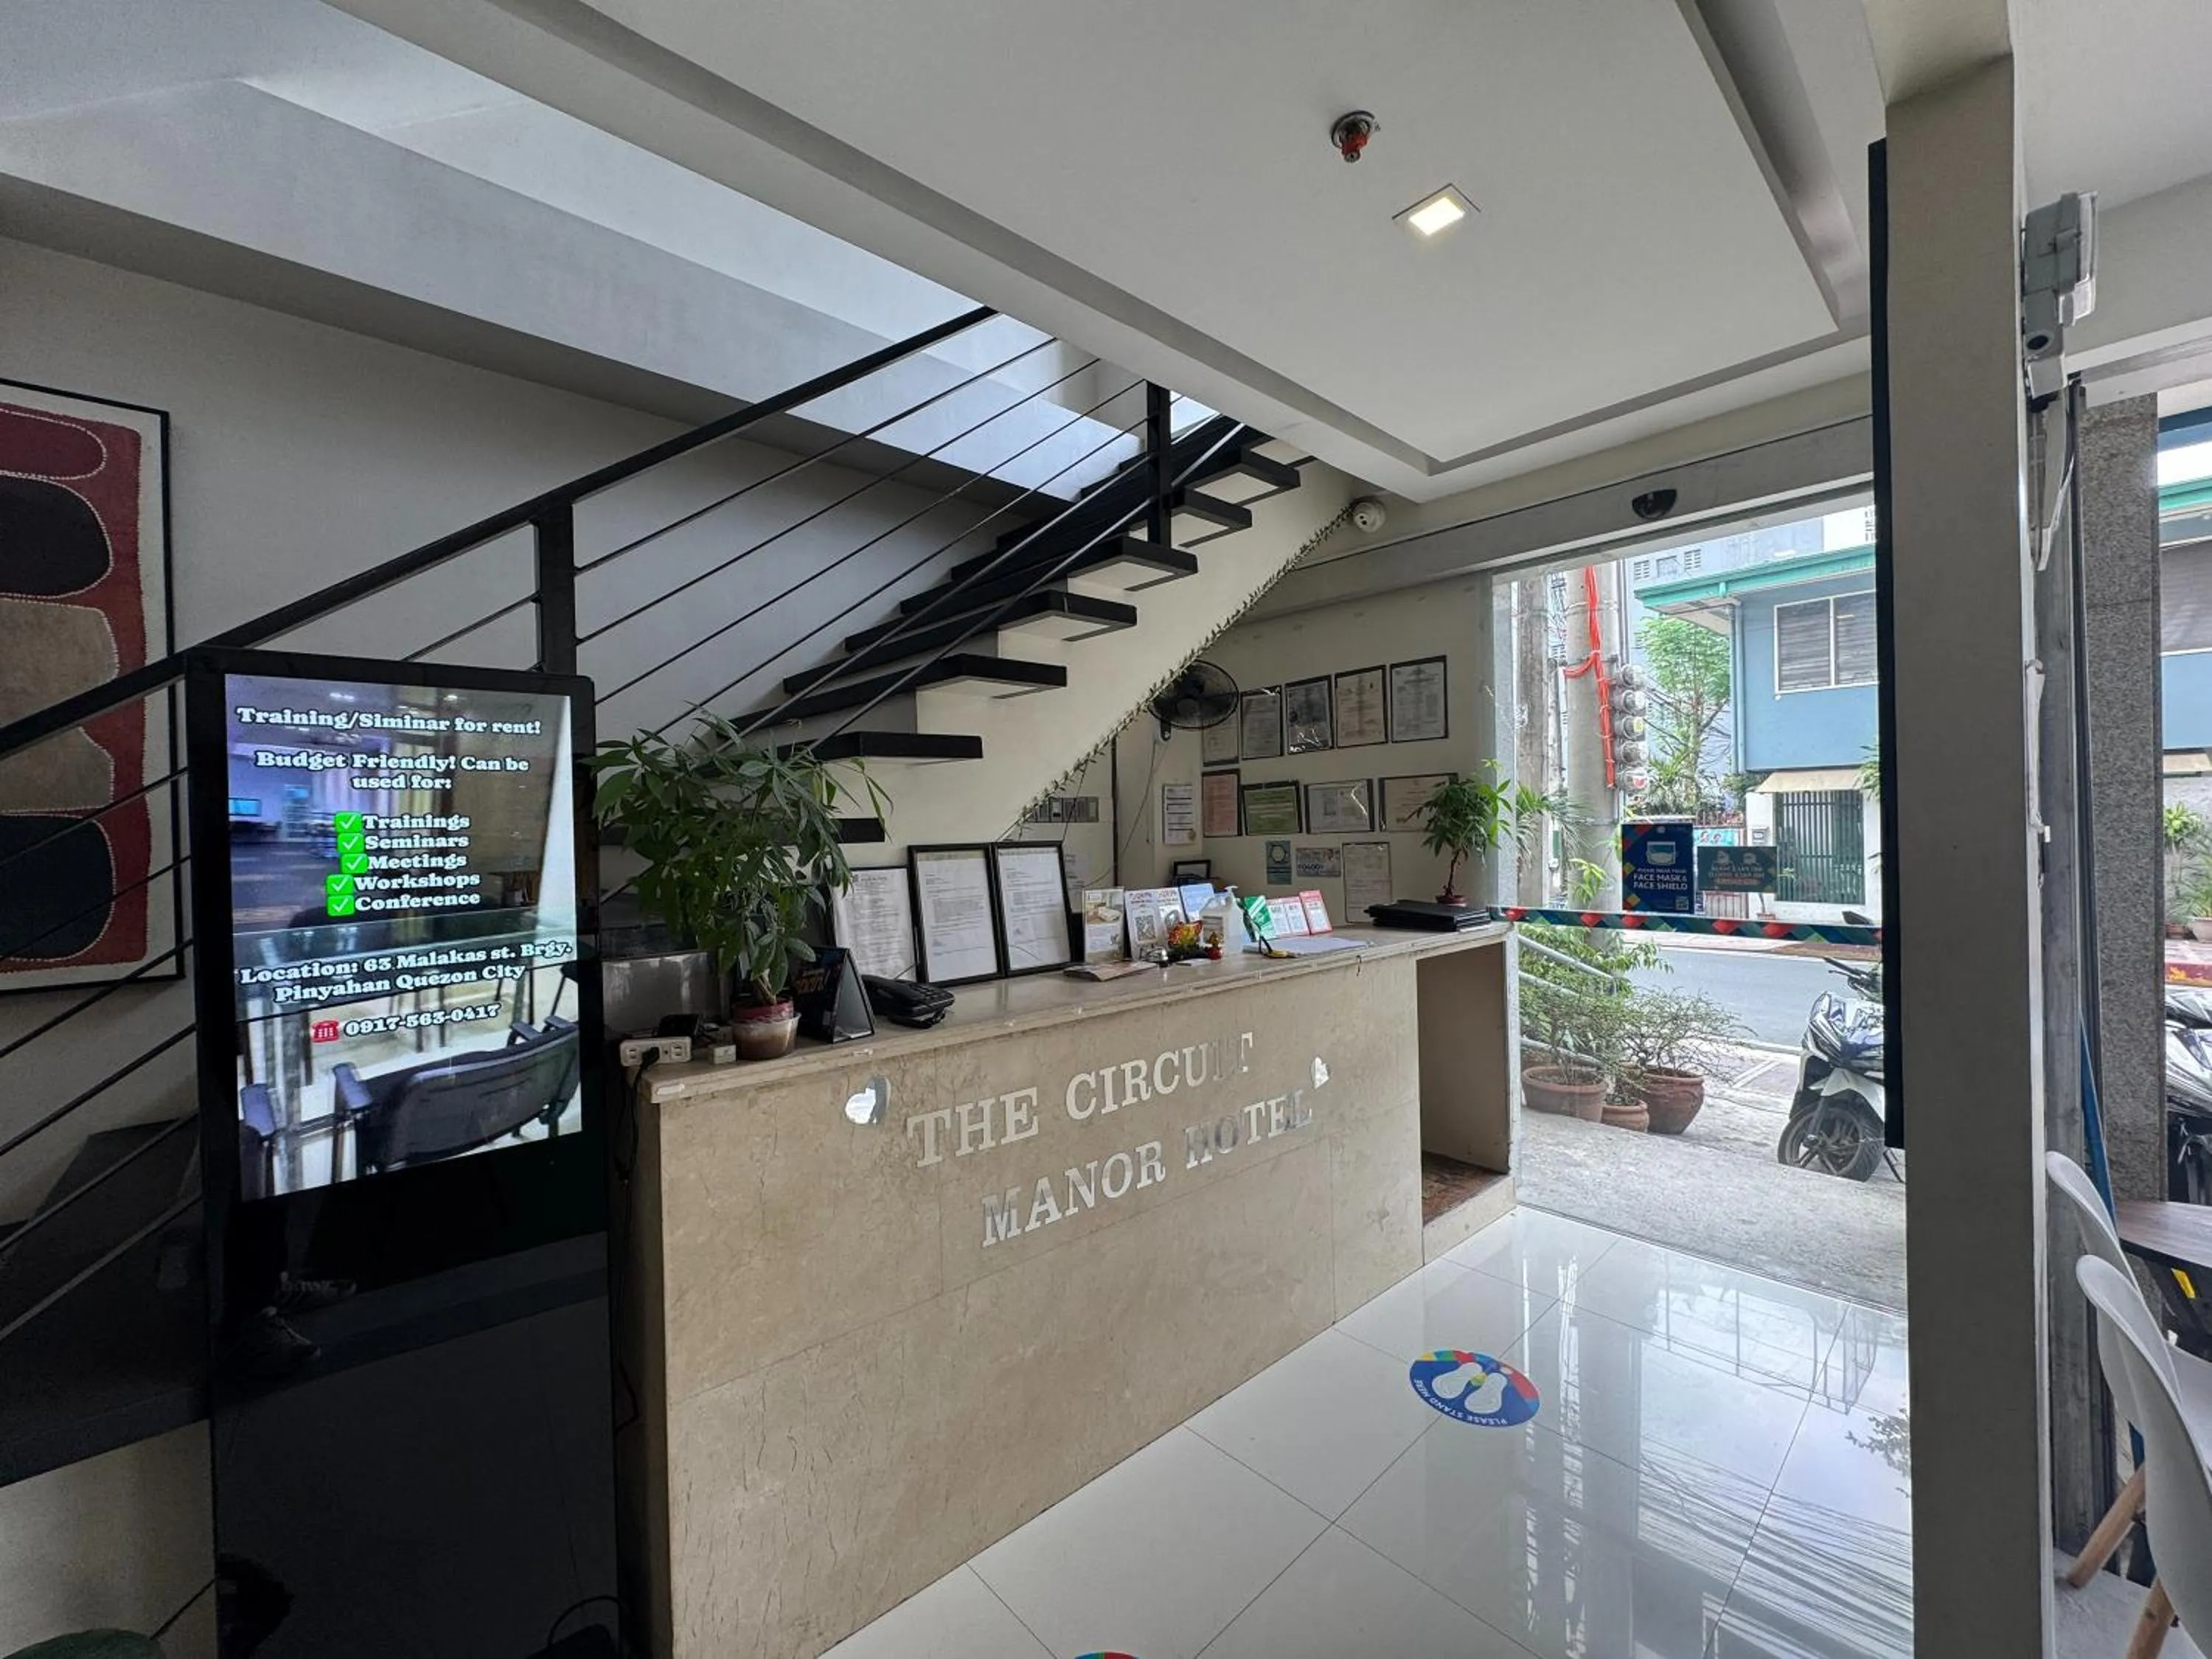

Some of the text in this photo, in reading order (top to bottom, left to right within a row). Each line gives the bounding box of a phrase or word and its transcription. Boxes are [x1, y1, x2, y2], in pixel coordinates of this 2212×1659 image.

[236, 707, 541, 734] Training/Siminar for rent!
[256, 751, 529, 772] Budget Friendly! Can be
[352, 775, 452, 790] used for:
[362, 814, 470, 831] Trainings
[364, 834, 469, 850] Seminars
[367, 853, 467, 870] Meetings
[354, 872, 481, 890] Workshops
[1633, 873, 1655, 881] FACE
[1657, 874, 1682, 883] MASK
[1633, 881, 1688, 891] FACE SHIELD
[355, 892, 481, 911] Conference
[240, 961, 358, 985] Location:
[396, 947, 486, 970] Malakas
[490, 944, 516, 959] st.
[521, 941, 572, 959] Brgy.
[274, 964, 526, 1003] Pinyahan Quezon City
[345, 1004, 501, 1036] 0917-563-0417
[906, 1032, 1253, 1168] THE CIRCUIT
[981, 1089, 1312, 1248] MANOR HOTEL
